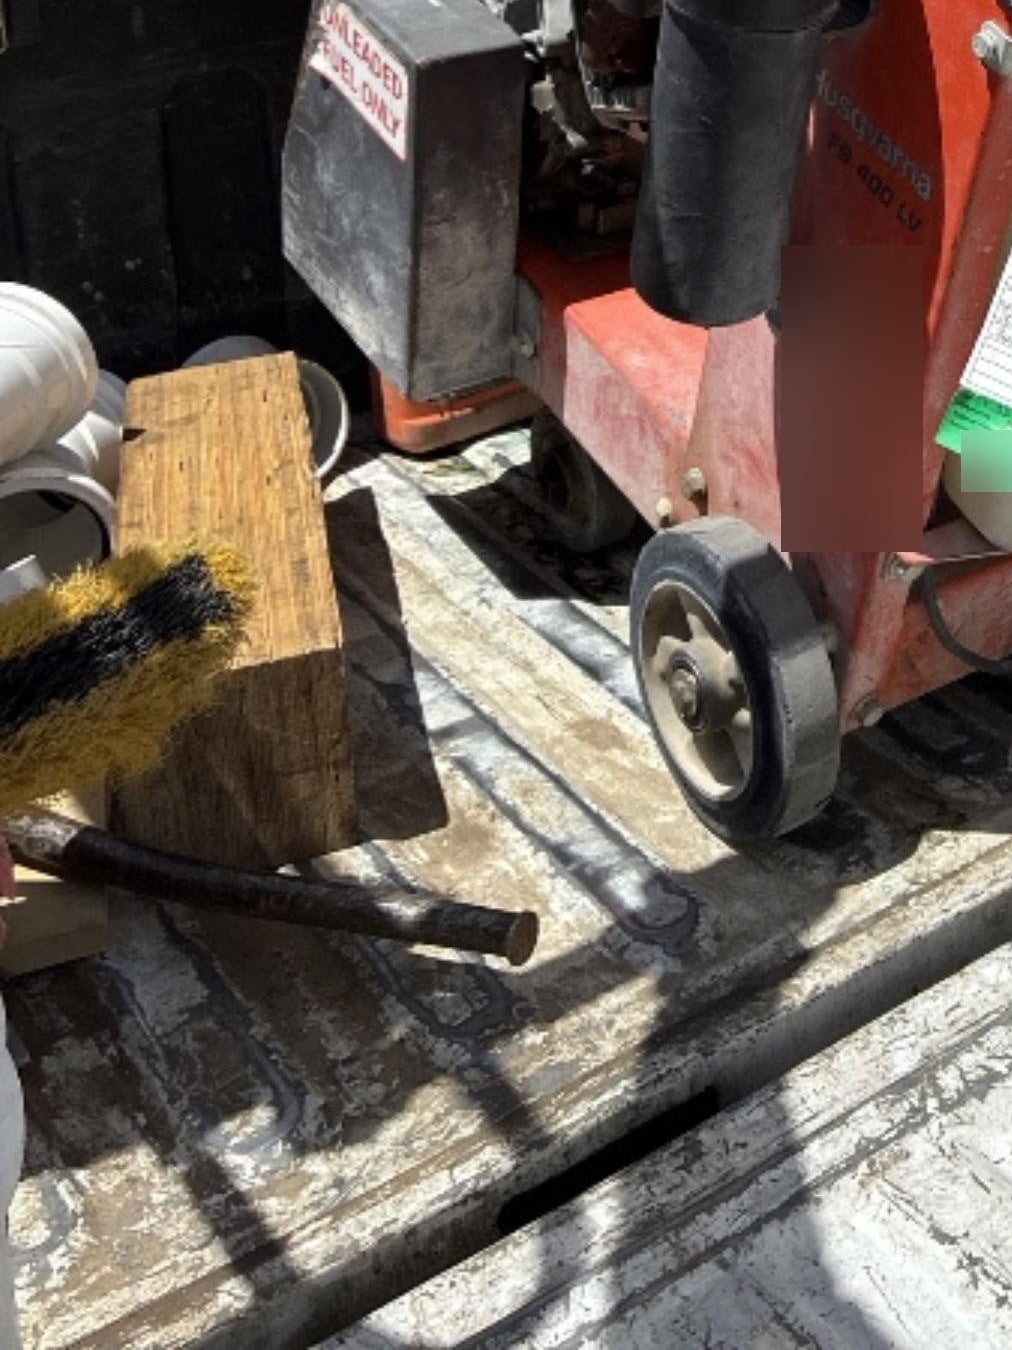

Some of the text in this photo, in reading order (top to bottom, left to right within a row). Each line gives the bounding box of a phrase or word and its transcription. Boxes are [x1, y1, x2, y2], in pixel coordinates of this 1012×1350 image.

[320, 4, 403, 100] UNLEADED
[322, 39, 404, 140] FUEL ONLY
[856, 164, 896, 210] 400
